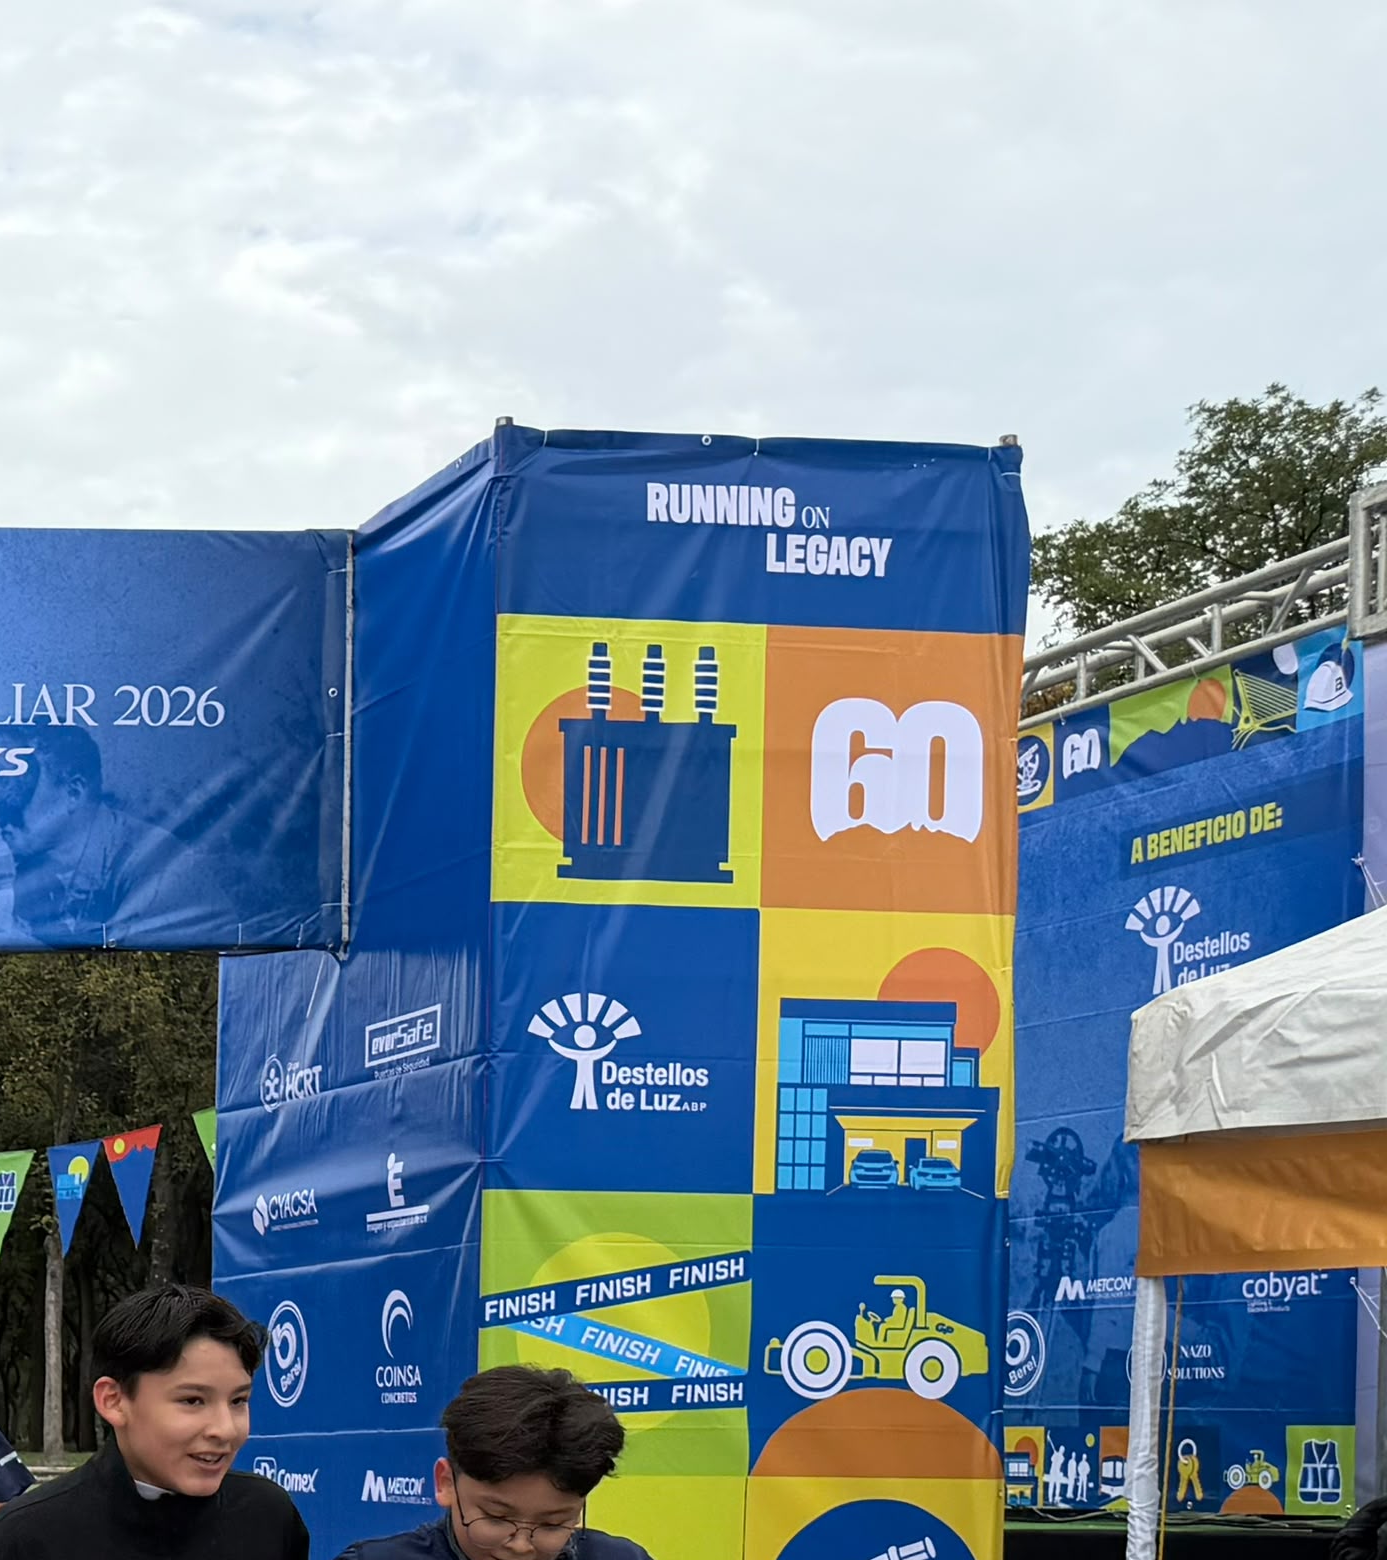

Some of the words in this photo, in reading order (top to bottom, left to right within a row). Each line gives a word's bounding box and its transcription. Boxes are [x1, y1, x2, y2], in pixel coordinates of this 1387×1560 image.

[646, 482, 796, 527] RUNNING
[801, 506, 830, 529] ON
[766, 533, 892, 577] LEGACY
[112, 684, 226, 729] 2026
[1062, 728, 1101, 780] 60
[809, 698, 984, 843] 60
[1130, 837, 1144, 864] A
[1147, 809, 1246, 861] BENEFICIO
[1249, 802, 1283, 835] DE:
[1173, 931, 1251, 964] Destellos
[1200, 963, 1230, 980] Lu
[285, 1065, 323, 1102] HCRT
[601, 1060, 710, 1087] Destellos
[606, 1089, 635, 1110] de
[640, 1089, 681, 1111] Luz
[682, 1101, 708, 1112] ABP
[268, 1188, 318, 1220] CYACSA
[484, 1290, 556, 1322] FINISH
[575, 1273, 652, 1305] FINISH
[668, 1257, 745, 1289] FINISH
[1086, 1277, 1133, 1293] METCON
[1242, 1271, 1322, 1302] cobyat
[580, 1325, 662, 1366] FINISH
[674, 1354, 729, 1378] FINI
[1179, 1344, 1212, 1359] NAZO
[376, 1364, 422, 1388] COINSA
[1008, 1355, 1038, 1385] Berel
[1167, 1366, 1225, 1381] SOLUTIONS
[587, 1386, 650, 1406] ISH
[670, 1382, 744, 1404] FINISH
[277, 1468, 319, 1494] Comex
[387, 1477, 425, 1495] METCON
